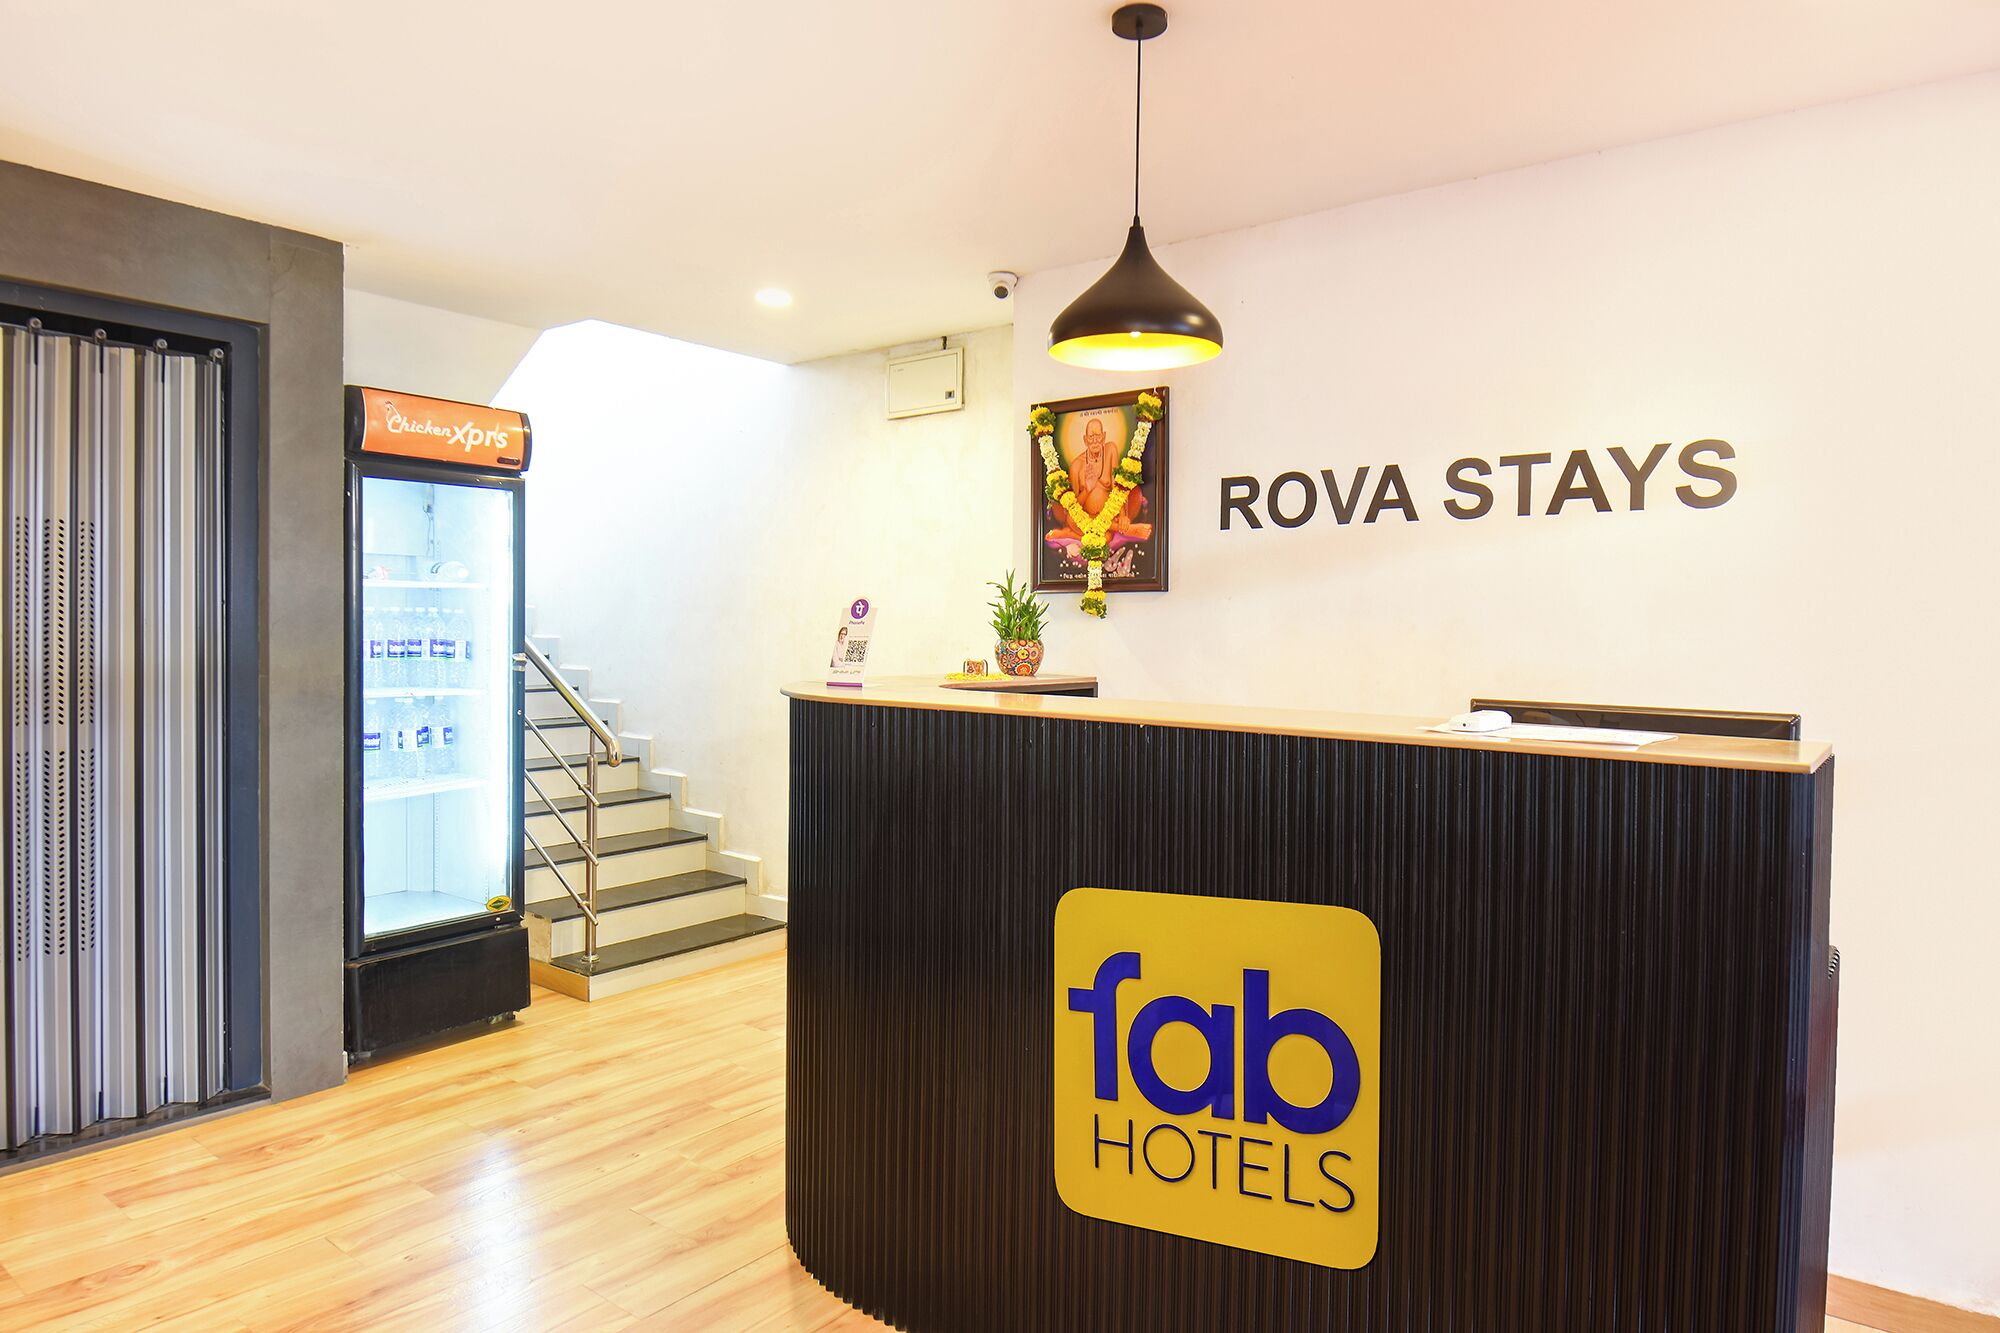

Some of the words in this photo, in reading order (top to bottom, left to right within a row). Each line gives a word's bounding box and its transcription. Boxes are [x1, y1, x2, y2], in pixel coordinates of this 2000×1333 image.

[387, 415, 452, 437] Chicken
[1219, 464, 1420, 531] ROVA
[1443, 438, 1738, 521] STAYS
[1067, 951, 1361, 1135] fab
[1094, 1113, 1356, 1214] HOTELS
